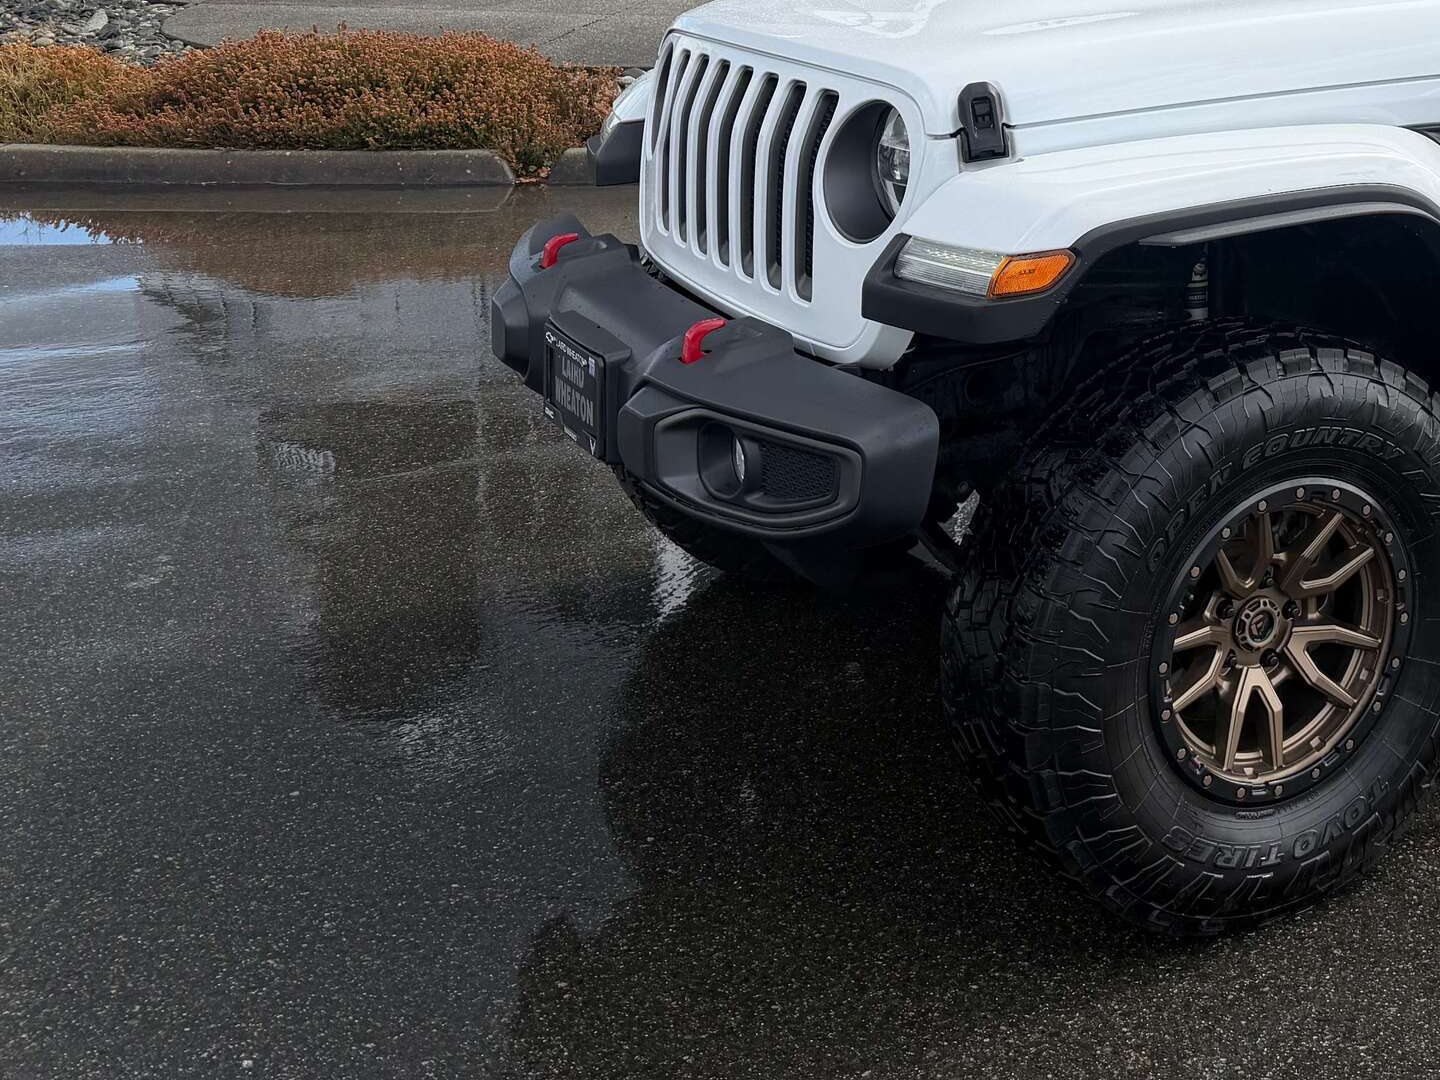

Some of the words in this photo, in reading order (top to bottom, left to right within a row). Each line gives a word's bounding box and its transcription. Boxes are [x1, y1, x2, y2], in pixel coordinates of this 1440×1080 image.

[555, 375, 594, 427] WHEATON
[1242, 426, 1406, 469] COUNTRY
[1293, 776, 1391, 860] TOYO
[1161, 826, 1284, 869] TIRES
